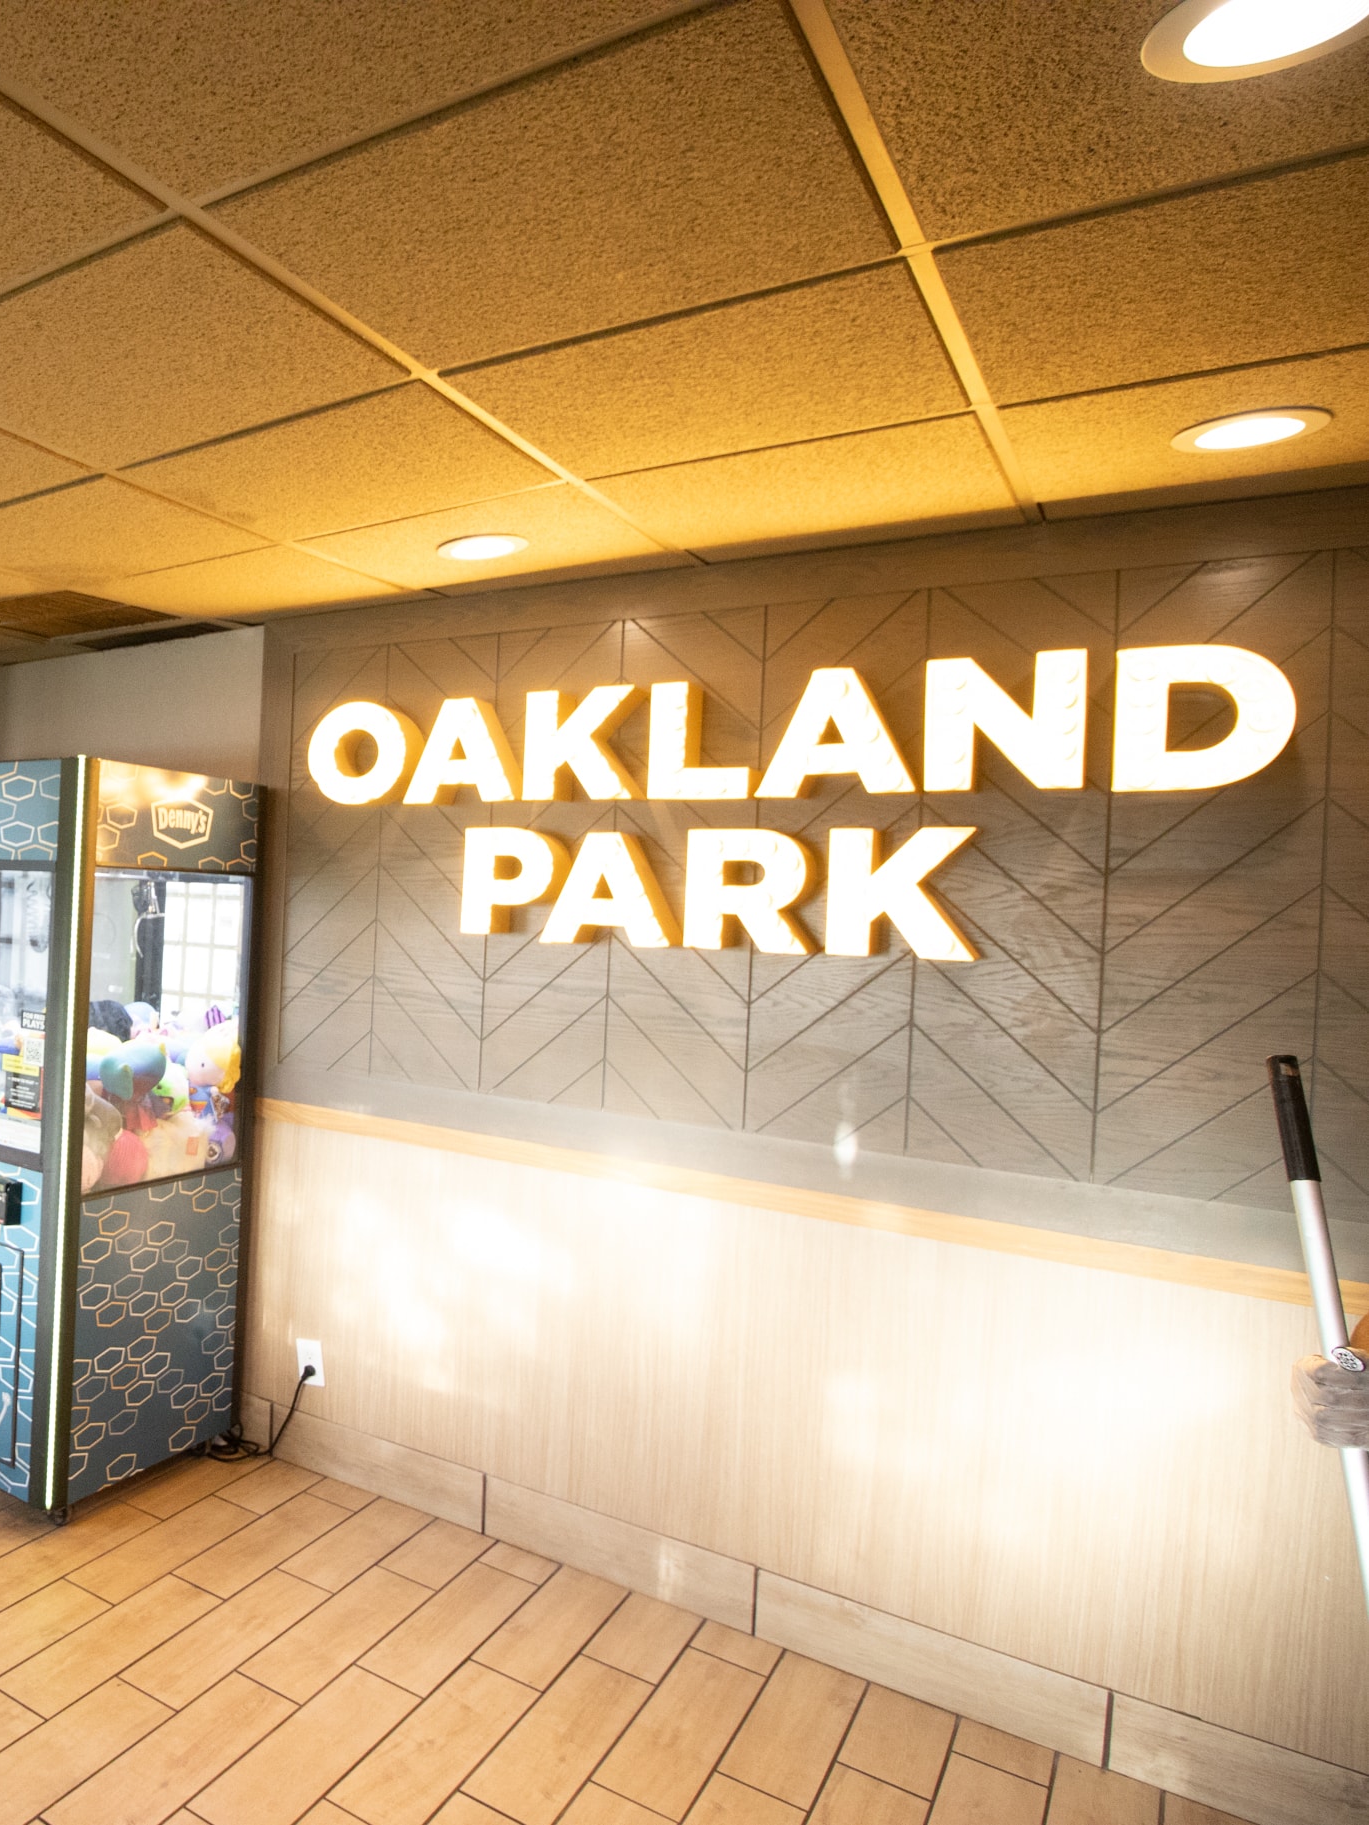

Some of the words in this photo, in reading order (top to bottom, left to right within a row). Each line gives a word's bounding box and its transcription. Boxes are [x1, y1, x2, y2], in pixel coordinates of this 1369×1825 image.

[306, 643, 1298, 806] OAKLAND
[157, 807, 207, 835] Denny's
[460, 825, 981, 961] PARK
[22, 1011, 33, 1020] FOR
[22, 1018, 46, 1030] PLAYS
